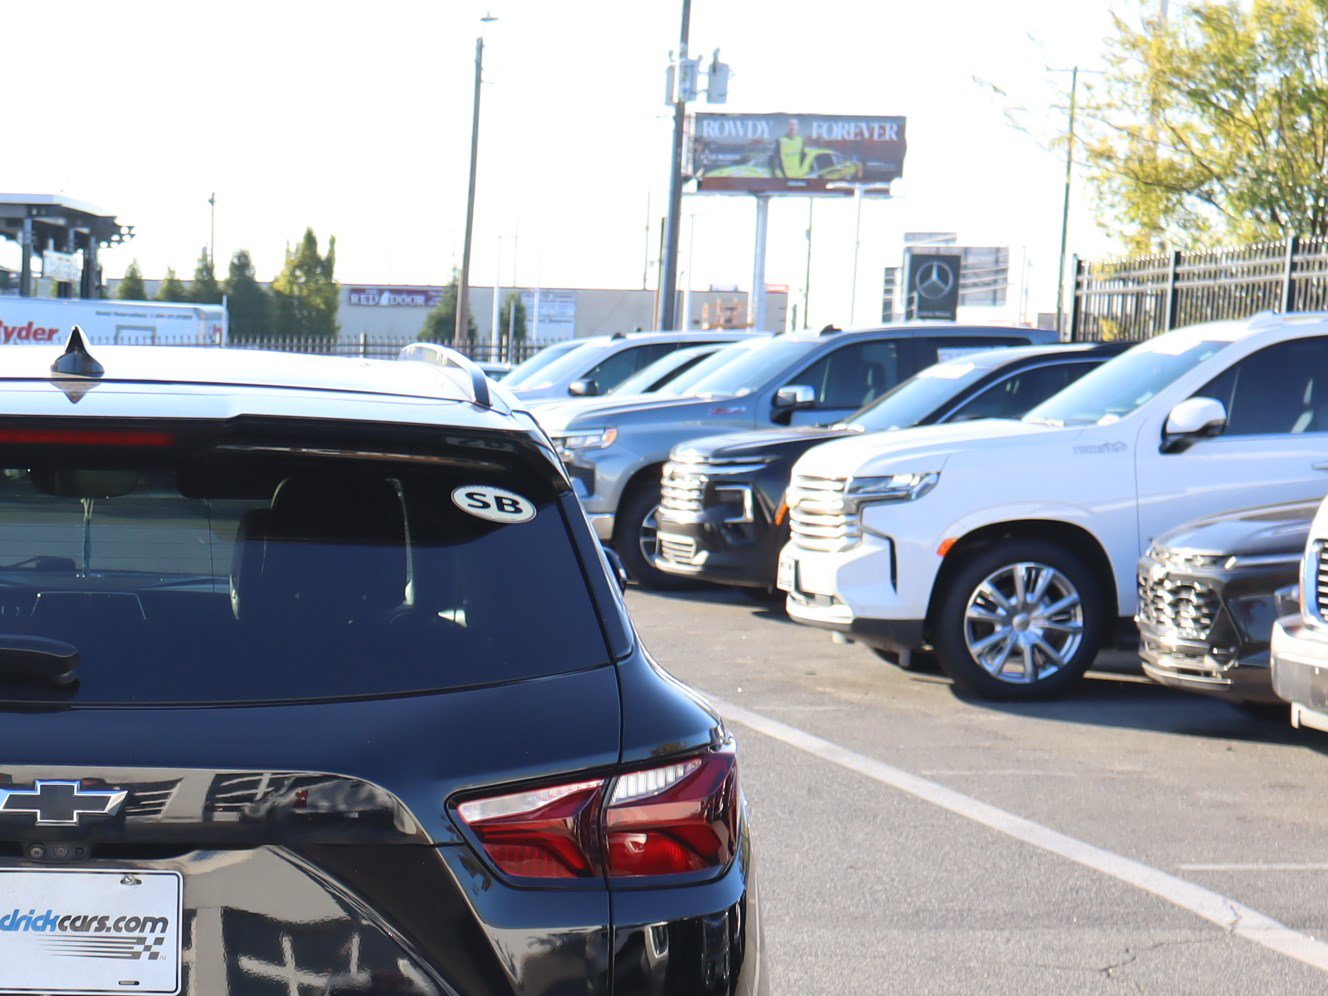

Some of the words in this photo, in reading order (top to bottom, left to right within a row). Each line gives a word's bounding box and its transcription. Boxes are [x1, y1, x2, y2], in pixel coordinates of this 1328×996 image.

[702, 119, 774, 139] ROWDY
[812, 121, 899, 142] FOREVER
[351, 293, 379, 305] RED
[391, 294, 425, 306] DOOR
[464, 491, 524, 514] SB
